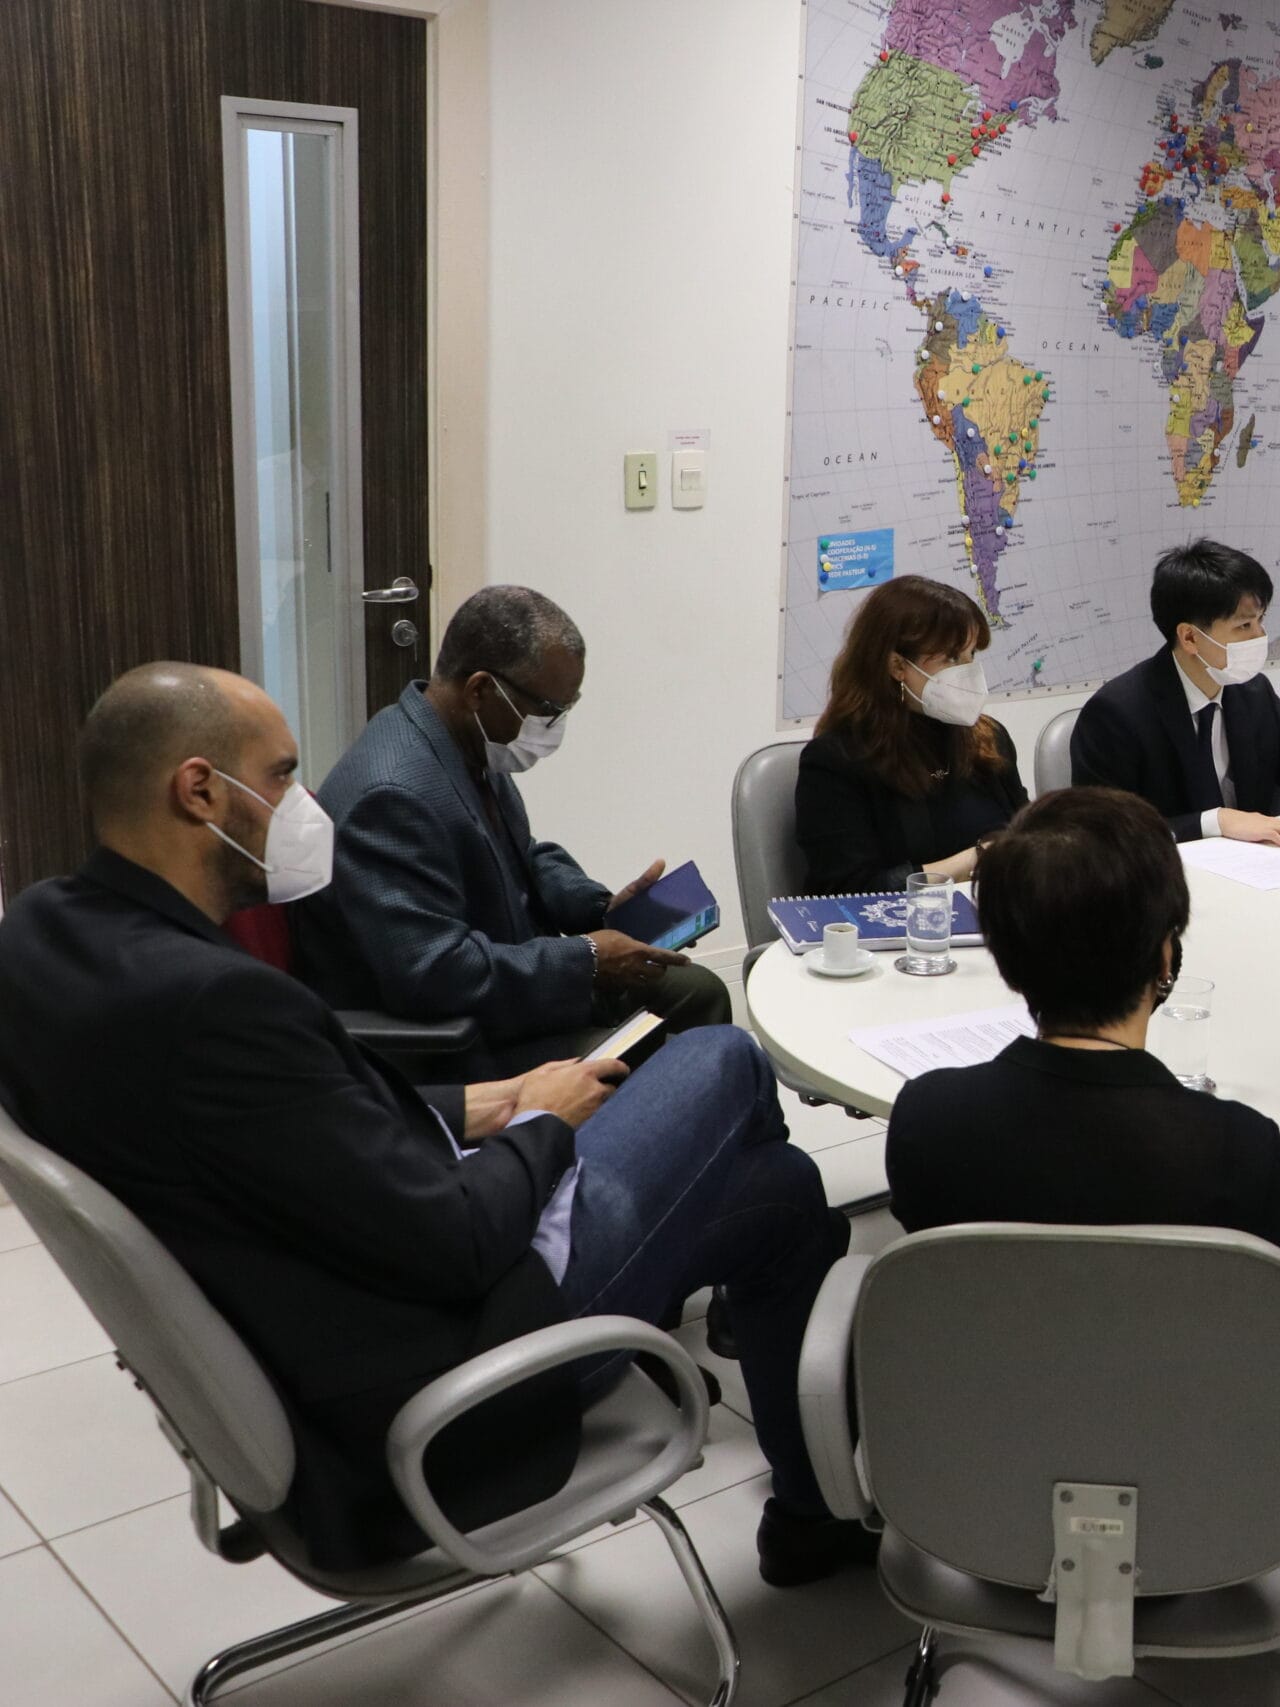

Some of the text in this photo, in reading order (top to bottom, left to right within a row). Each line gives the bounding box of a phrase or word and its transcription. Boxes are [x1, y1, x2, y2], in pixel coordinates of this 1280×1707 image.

[980, 210, 1087, 238] ATLANTIC
[810, 294, 890, 311] PACIFIC
[1042, 341, 1100, 352] OCEAN
[823, 452, 878, 466] OCEAN
[828, 539, 855, 548] NIDADES
